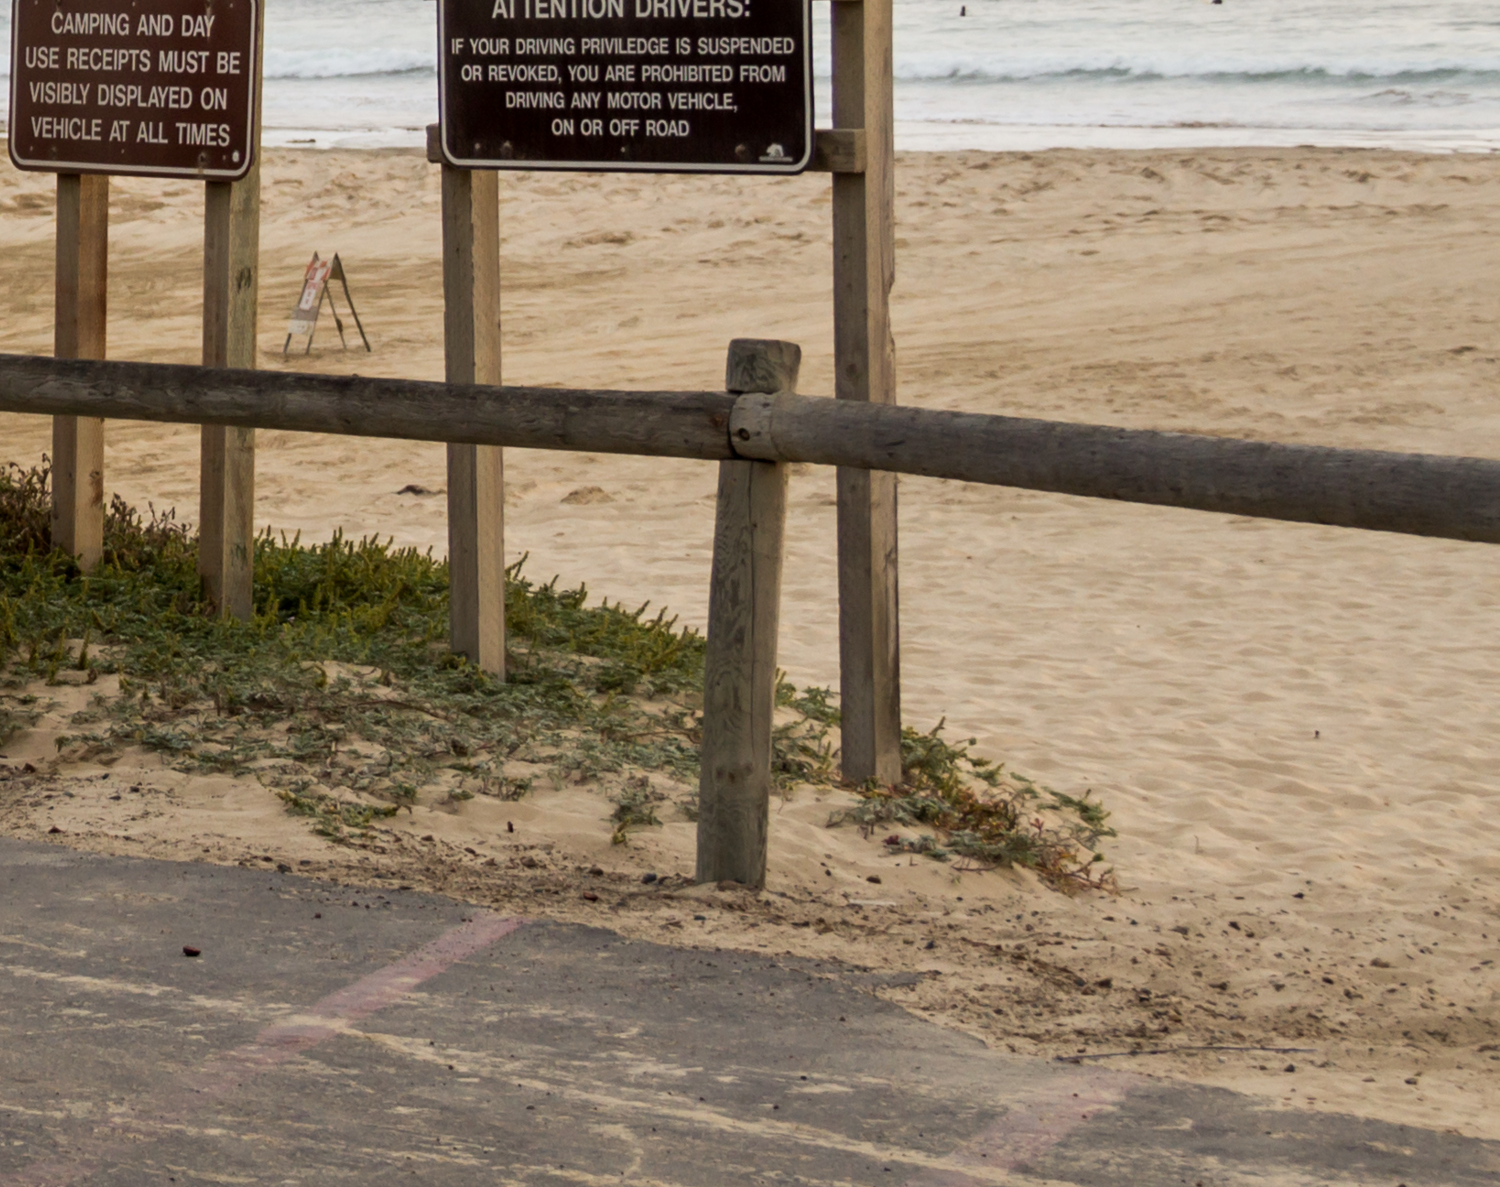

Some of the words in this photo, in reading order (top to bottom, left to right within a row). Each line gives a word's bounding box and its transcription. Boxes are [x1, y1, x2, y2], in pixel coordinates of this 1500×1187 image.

[51, 12, 130, 35] CAMPING
[137, 14, 173, 36] AND
[182, 15, 215, 37] DAY
[451, 39, 464, 55] IF
[470, 38, 509, 55] YOUR
[516, 38, 575, 55] DRIVING
[581, 38, 669, 55] PRIVILEDGE
[676, 38, 691, 55] IS
[698, 37, 795, 55] SUSPENDED
[25, 47, 60, 68] USE
[67, 48, 151, 72] RECEIPTS
[159, 51, 209, 73] MUST
[217, 52, 241, 74] BE
[461, 65, 482, 82] OR
[488, 65, 562, 84] REVOKED,
[568, 65, 599, 82] YOU
[605, 65, 635, 82] ARE
[642, 65, 733, 82] PROHIBITED
[740, 65, 786, 82] FROM
[29, 82, 91, 104] VISIBLY
[98, 84, 193, 109] DISPLAYED
[200, 88, 228, 110] ON
[506, 92, 565, 109] DRIVING
[571, 92, 601, 109] ANY
[608, 92, 662, 110] MOTOR
[668, 92, 738, 112] VEHICLE,
[31, 117, 102, 141] VEHICLE
[109, 120, 130, 142] AT
[137, 122, 168, 144] ALL
[176, 123, 230, 146] TIMES
[551, 119, 574, 135] ON
[580, 119, 603, 136] OR
[609, 119, 639, 136] OFF
[646, 120, 689, 137] ROAD
